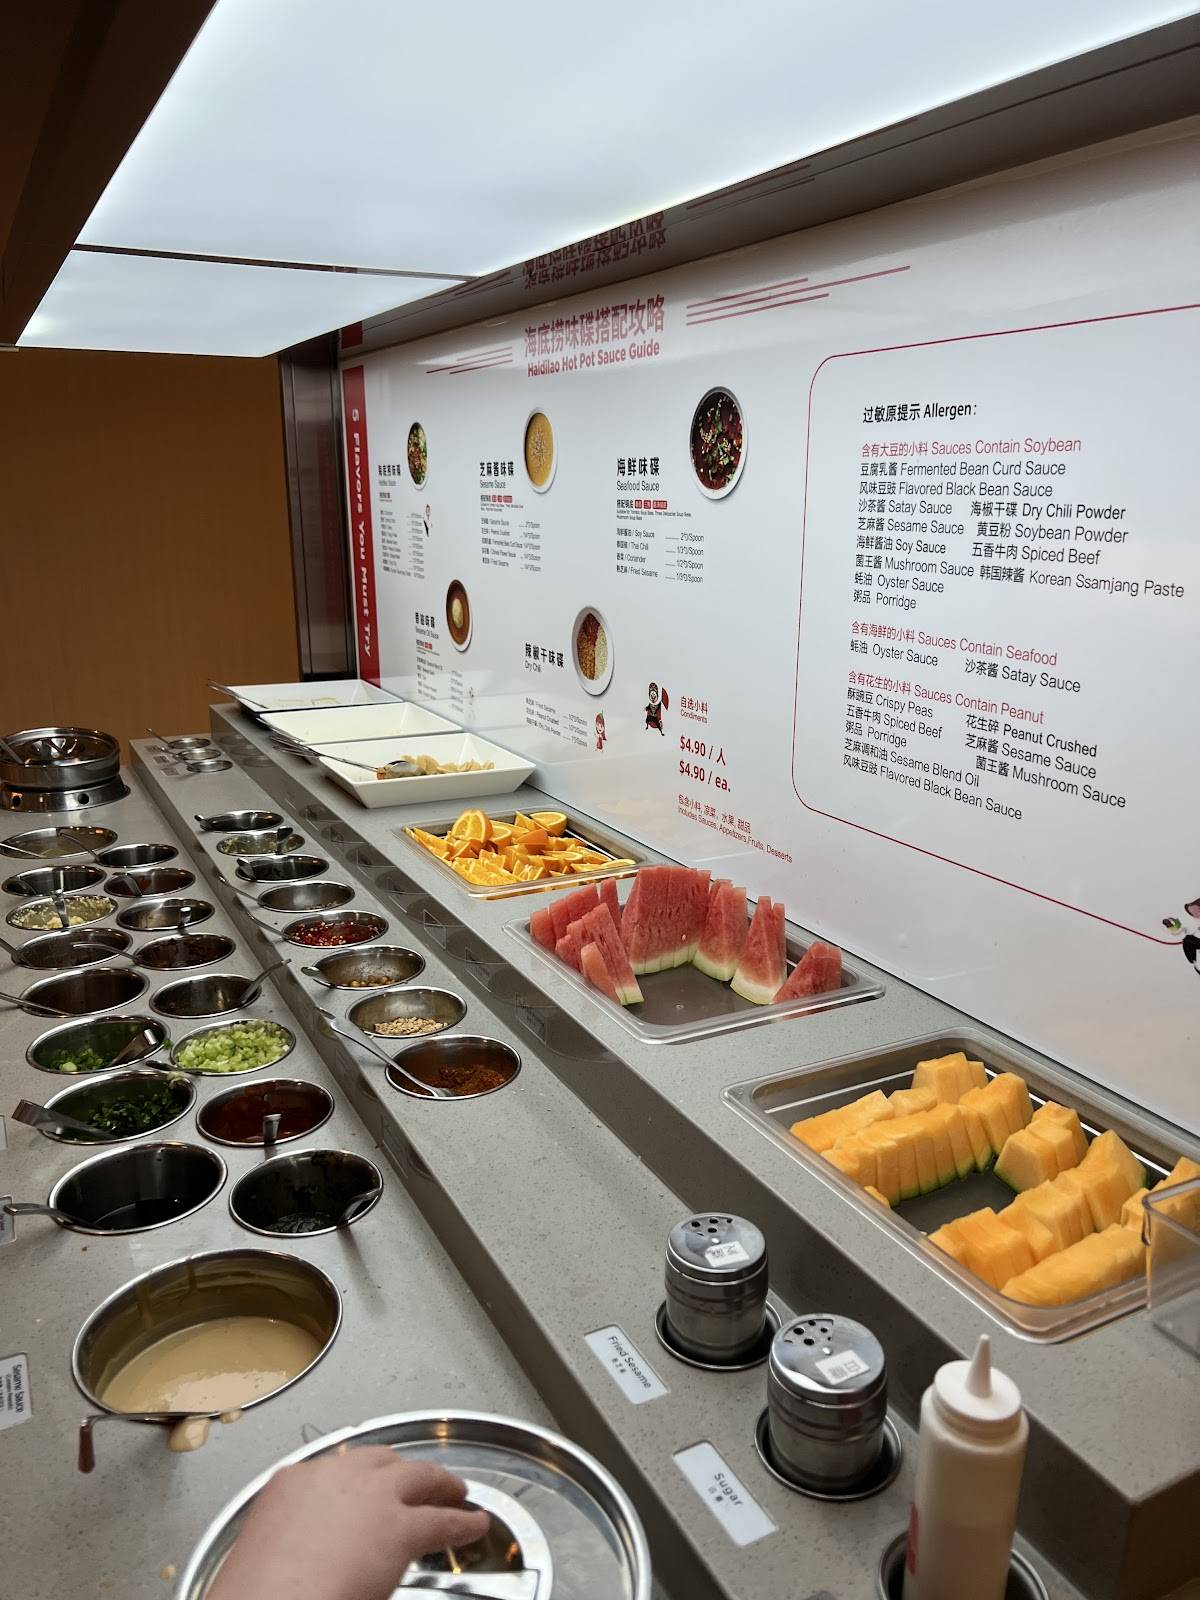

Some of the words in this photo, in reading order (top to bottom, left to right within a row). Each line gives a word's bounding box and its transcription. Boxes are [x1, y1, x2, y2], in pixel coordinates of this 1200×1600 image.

[525, 294, 665, 358] 海底捞味碟搭配攻略
[528, 361, 560, 377] Haidilao
[562, 357, 578, 371] Hot
[579, 352, 595, 368] Pot
[598, 347, 626, 365] Sauce
[629, 339, 660, 359] Guide
[352, 409, 360, 422] 5
[863, 403, 920, 423] 过敏原提示
[862, 442, 928, 457] 含有大豆的小料
[932, 441, 971, 455] Sauces
[975, 439, 1020, 455] Contain
[1024, 438, 1081, 454] Soybean
[353, 432, 363, 514] Flavors
[617, 457, 660, 476] 海鲜味碟
[860, 463, 898, 477] 豆腐乳酱
[900, 462, 956, 477] Fermented
[960, 462, 989, 476] Bean
[992, 461, 1021, 475] Curd
[1025, 461, 1066, 475] Sauce
[617, 481, 640, 491] Seafood
[642, 481, 659, 492] Sauce
[859, 482, 896, 495] 风味豆豉
[899, 482, 943, 496] Flavored
[946, 482, 976, 496] Black
[979, 483, 1009, 497] Bean
[1013, 483, 1053, 497] Sauce
[858, 499, 886, 513] 沙茶酱
[888, 500, 917, 516] Satay
[919, 501, 952, 515] Sauce
[970, 502, 1018, 517] 海椒干碟
[1022, 503, 1043, 520] Dry
[1046, 503, 1072, 519] Chili
[1076, 504, 1126, 520] Powder
[357, 520, 365, 560] You
[857, 518, 885, 532] 芝麻酱
[887, 519, 928, 534] Sesame
[930, 520, 964, 535] Sauce
[977, 522, 1012, 538] 黄豆粉
[1015, 523, 1071, 542] Soybean
[1075, 525, 1129, 543] Powder
[856, 536, 893, 551] 海鲜酱油
[895, 538, 914, 554] Soy
[916, 540, 946, 554] Sauce
[972, 542, 1018, 560] 五香牛肉
[1021, 545, 1065, 565] Spiced
[1068, 548, 1100, 565] Beef
[855, 555, 883, 570] 菌王酱
[885, 556, 938, 575] Mushroom
[940, 560, 974, 577] Sauce
[361, 567, 369, 617] Must
[854, 572, 872, 586] 蚝油
[877, 574, 909, 591] Oyster
[912, 578, 944, 593] Sauce
[979, 565, 1025, 583] 韩国辣酱
[1029, 569, 1072, 588] Korean
[1076, 574, 1139, 596] Ssamjang
[1144, 580, 1185, 598] Paste
[853, 590, 870, 604] 粥品
[876, 592, 916, 610] Porridge
[850, 639, 868, 654] 蚝油
[872, 644, 904, 662] Oyster
[907, 649, 938, 667] Sauce
[851, 621, 915, 644] 含有海鲜的小料
[918, 632, 956, 650] Sauces
[960, 639, 1002, 657] Contain
[1006, 645, 1057, 666] Seafood
[965, 658, 999, 678] 沙茶酱
[1002, 666, 1037, 686] Satay
[1040, 673, 1081, 693] Sauce
[680, 697, 707, 714] 自选小料
[848, 670, 911, 696] 含有花生的小料
[914, 684, 952, 704] Sauces
[955, 693, 998, 714] Contain
[1001, 703, 1044, 724] Peanut
[876, 694, 906, 714] Crispy
[908, 701, 933, 718] Peas
[680, 710, 707, 723] Condiments
[846, 704, 881, 725] 五香牛肉
[883, 713, 915, 733] Spiced
[918, 722, 944, 739] Beef
[845, 719, 862, 737] 粥品
[867, 726, 907, 749] Porridge
[966, 714, 999, 735] 花生碎
[1003, 723, 1044, 745] Peanut
[1046, 733, 1098, 758] Crushed
[680, 736, 706, 757] $4.90
[709, 746, 713, 759] /
[717, 748, 726, 766] 人
[844, 738, 887, 762] 芝麻调和油
[890, 751, 930, 773] Sesame
[933, 762, 962, 783] Blend
[965, 771, 980, 787] Oil
[965, 733, 999, 754] 芝麻酱
[1002, 742, 1052, 767] Sesame
[1055, 755, 1097, 779] Sauce
[679, 761, 704, 781] $4.90
[708, 771, 712, 784] /
[715, 776, 731, 792] ea.
[843, 754, 878, 777] 风味豆豉
[880, 760, 922, 788] Flavored
[923, 778, 951, 799] Black
[954, 788, 983, 808] Bean
[986, 797, 1022, 820] Sauce
[976, 755, 1009, 777] 菌王酱
[1013, 765, 1079, 797] Mushroom
[1082, 784, 1126, 809] Sauce
[678, 807, 697, 821] Includes
[767, 845, 792, 863] Desserts
[608, 1335, 629, 1358] Fried
[625, 1355, 651, 1389] Sesame
[714, 1472, 743, 1507] Sugar
